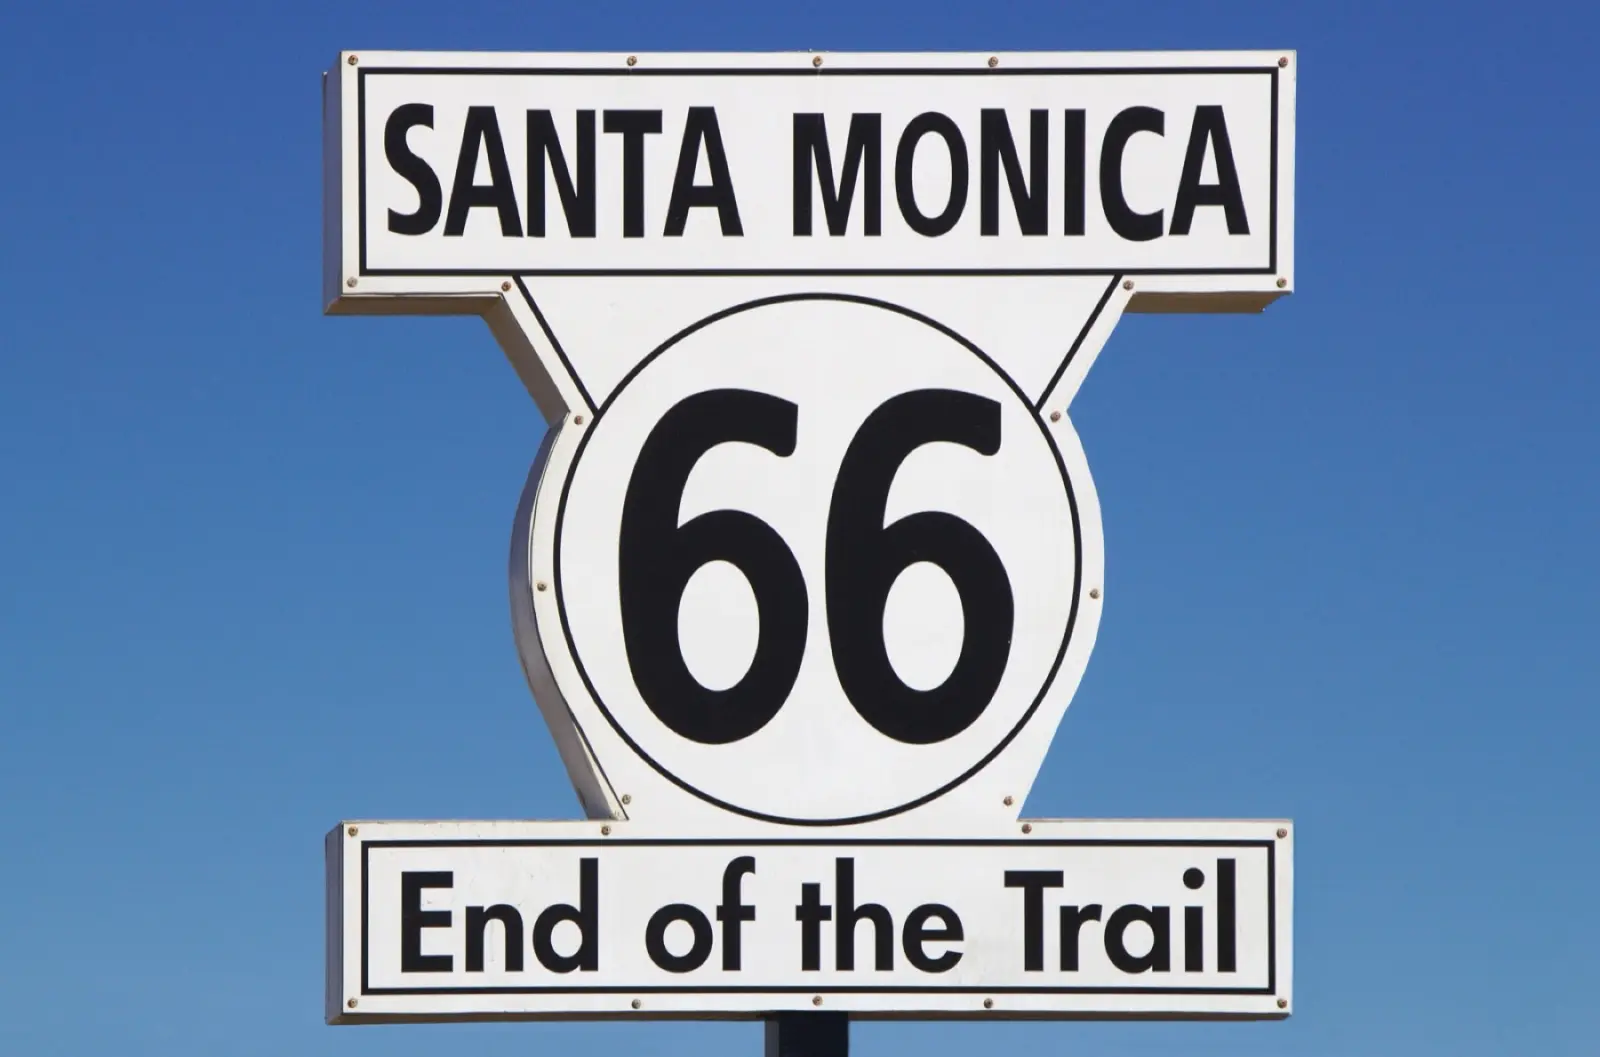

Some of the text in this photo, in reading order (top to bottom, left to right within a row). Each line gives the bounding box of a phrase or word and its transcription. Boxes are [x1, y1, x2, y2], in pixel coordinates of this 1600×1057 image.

[384, 104, 1250, 242] SANTA MONICA
[618, 388, 1015, 745] 66
[401, 856, 1237, 973] End of the Trail
